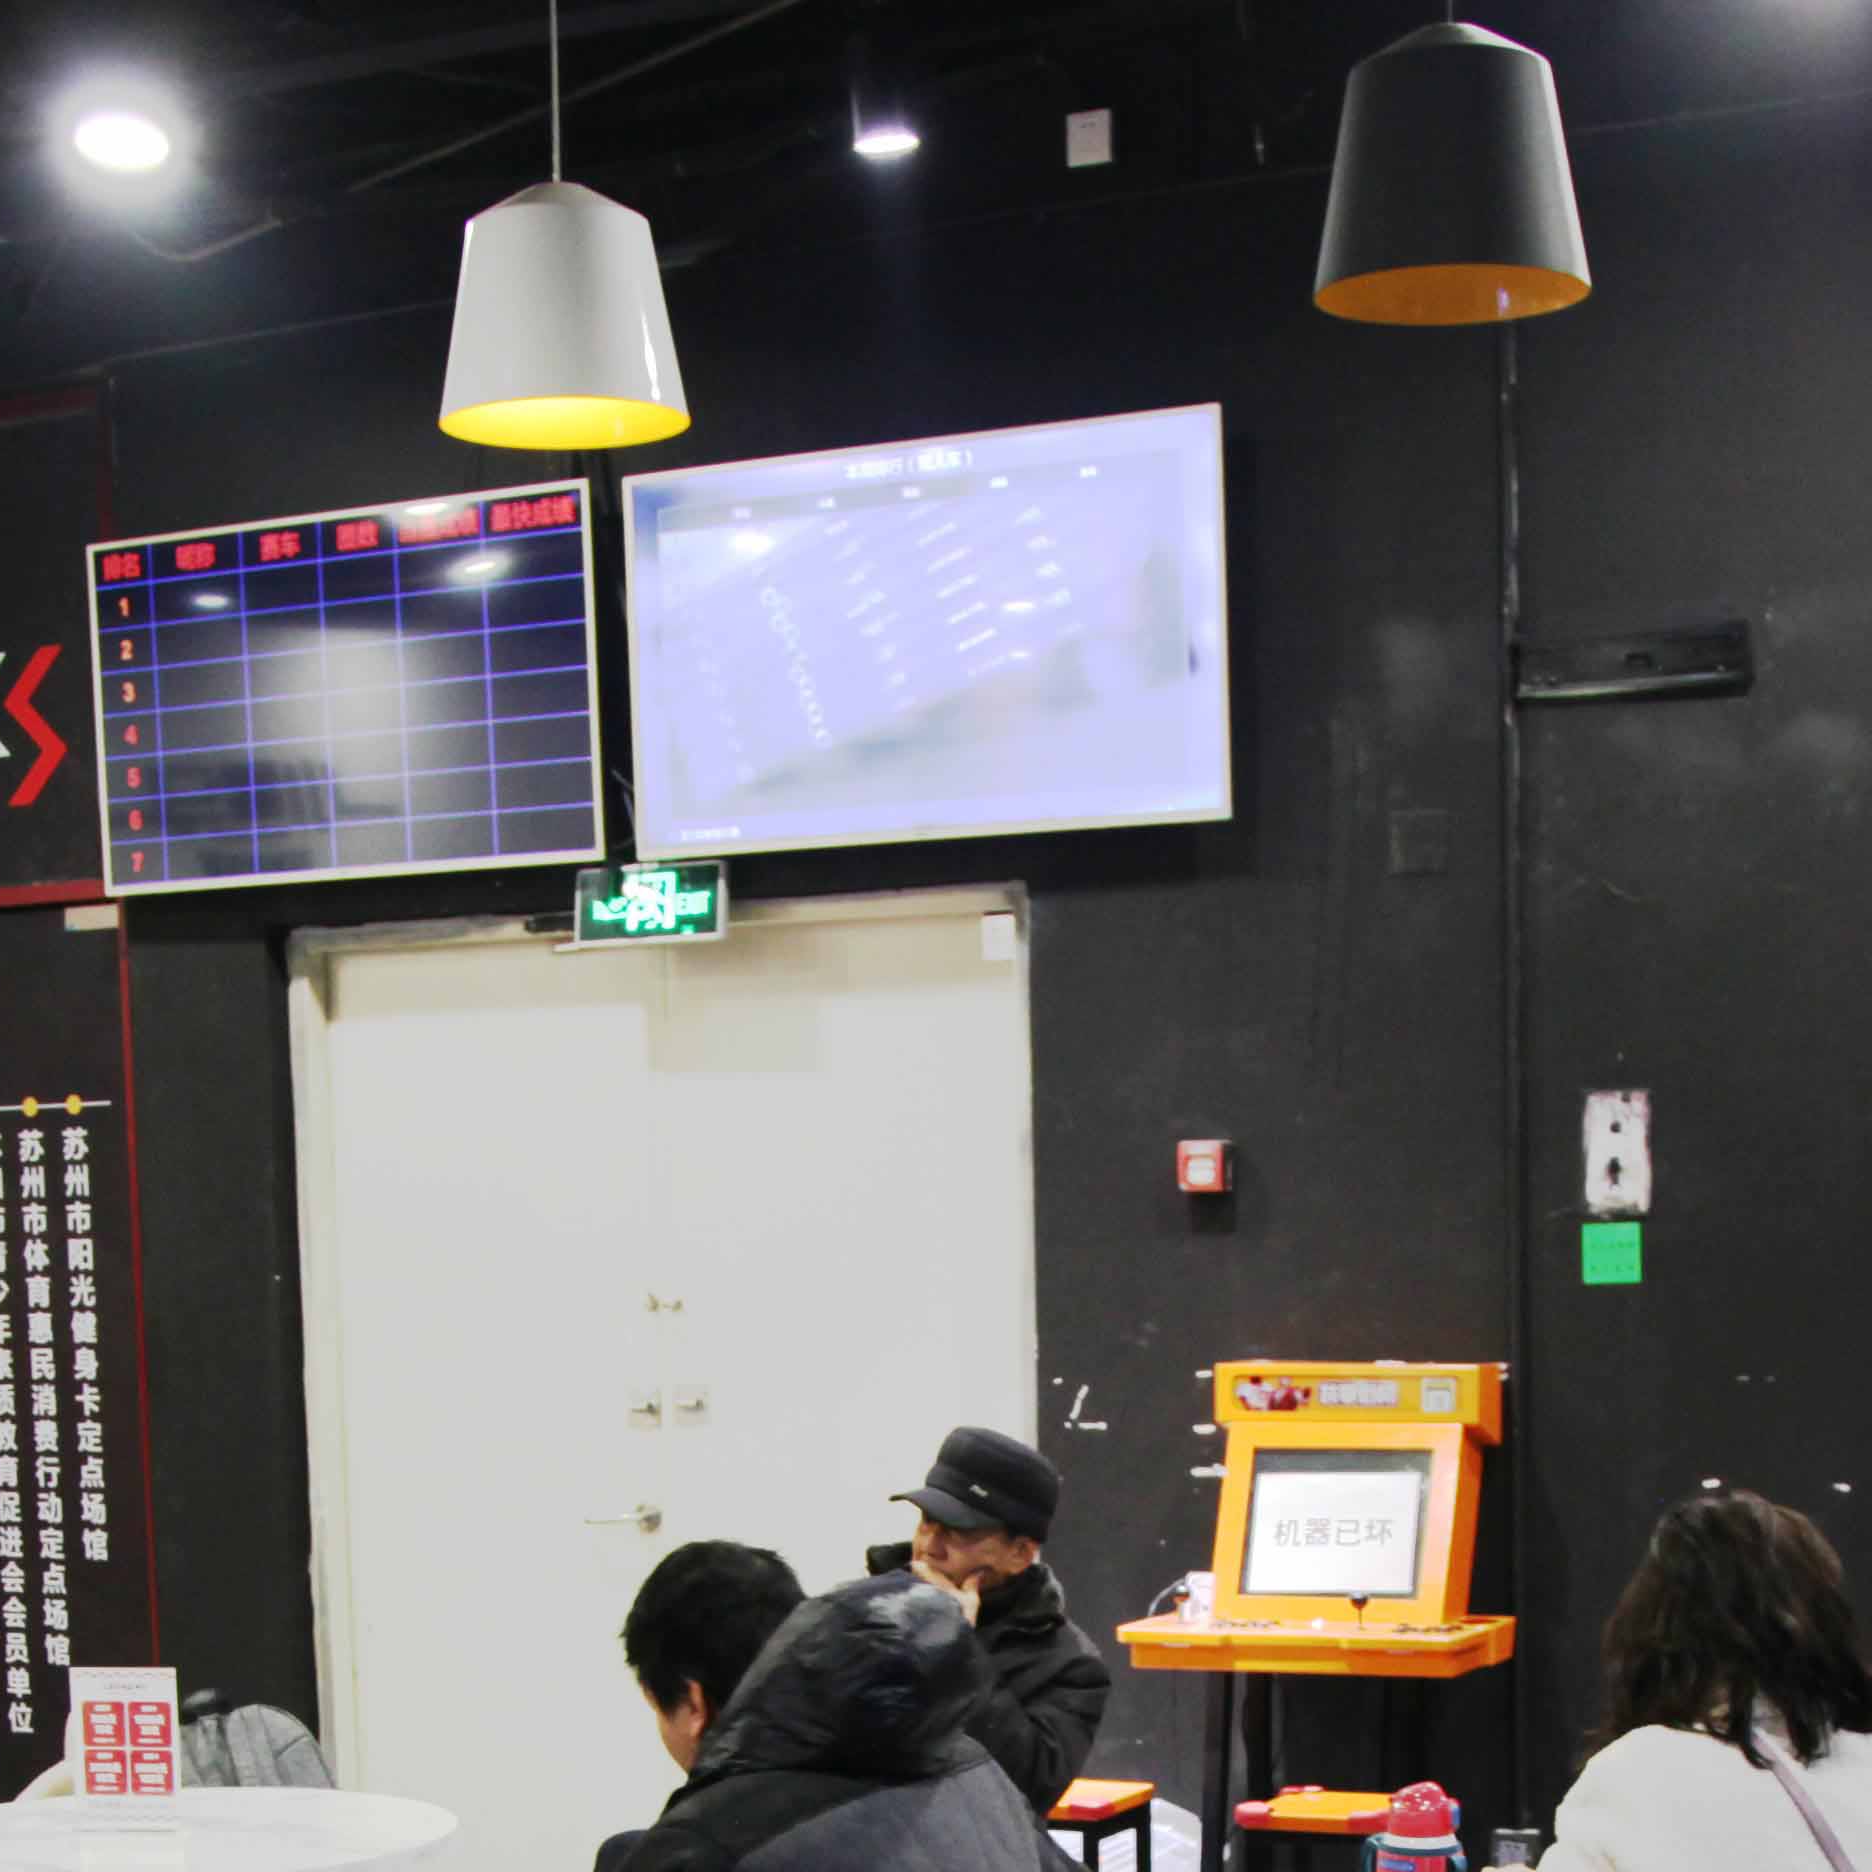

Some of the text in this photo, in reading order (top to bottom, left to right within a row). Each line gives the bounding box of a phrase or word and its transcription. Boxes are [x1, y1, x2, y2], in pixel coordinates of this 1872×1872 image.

[118, 597, 129, 616] 1
[121, 639, 133, 660] 2
[122, 681, 136, 703] 3
[124, 724, 139, 745] 4
[126, 767, 142, 788] 5
[128, 809, 143, 831] 6
[62, 1127, 109, 1562] 苏州市阳光健身卡定点场馆
[17, 1129, 70, 1667] 苏州市体育惠民消费行动定点场馆
[1273, 1518, 1393, 1548] 机器已坏
